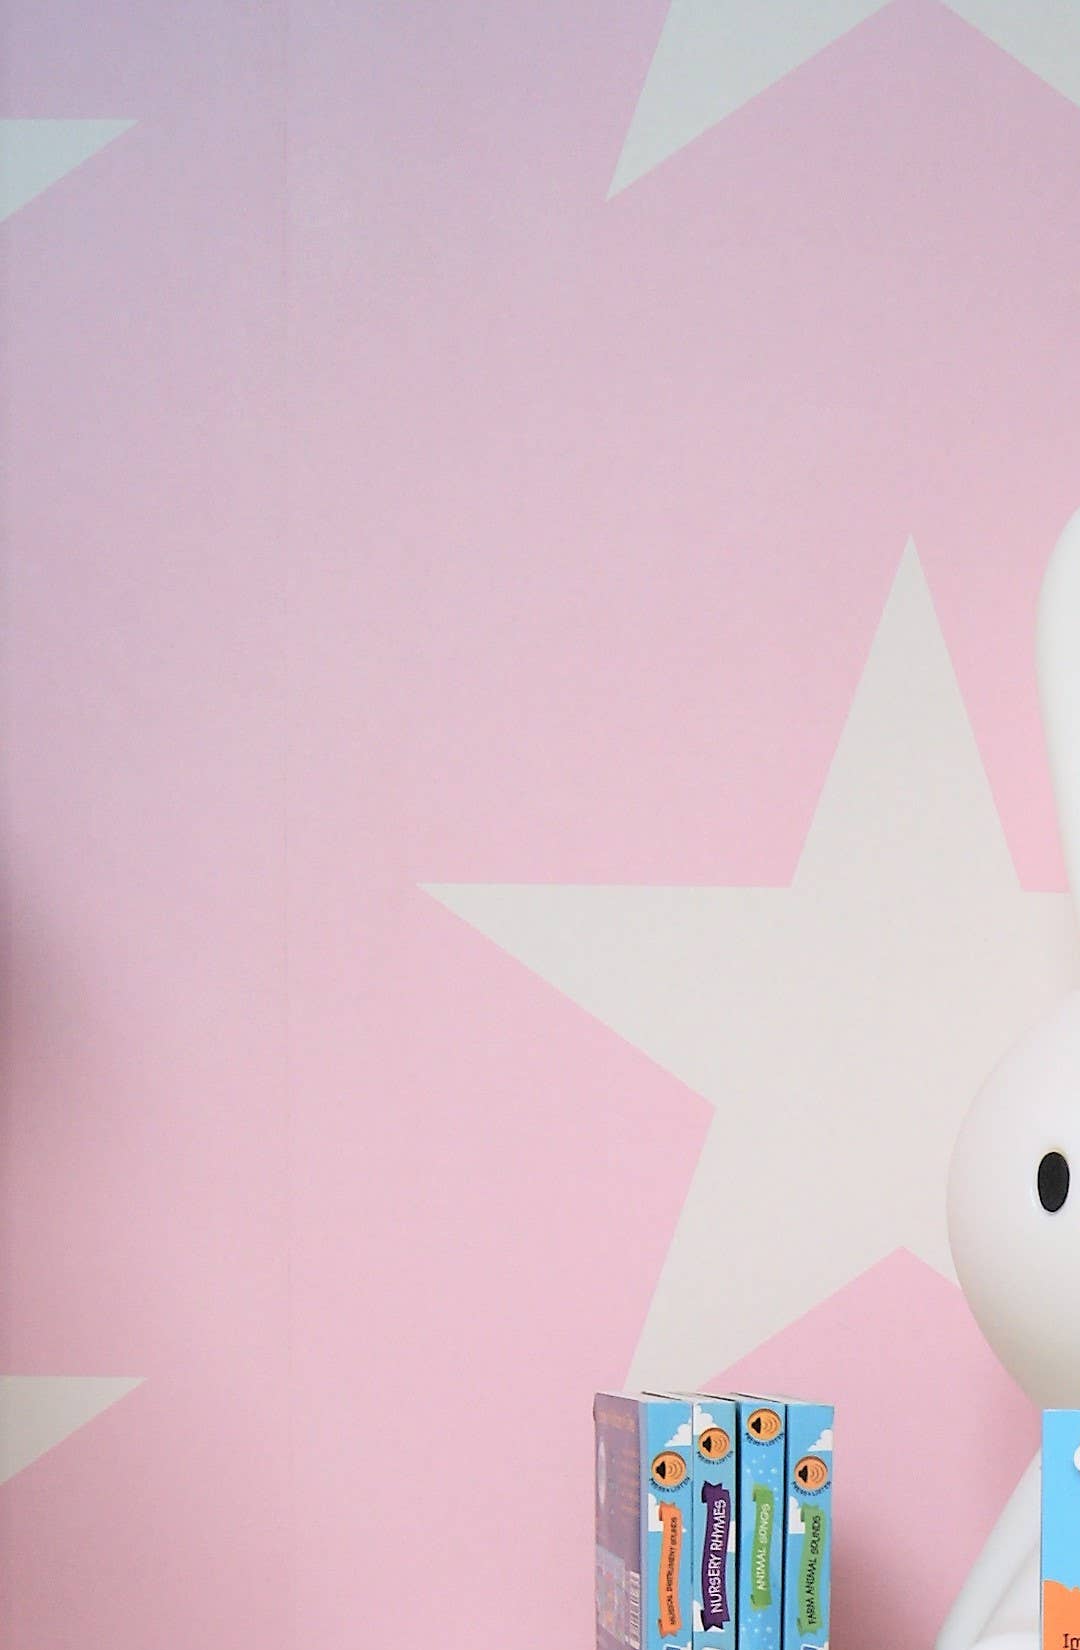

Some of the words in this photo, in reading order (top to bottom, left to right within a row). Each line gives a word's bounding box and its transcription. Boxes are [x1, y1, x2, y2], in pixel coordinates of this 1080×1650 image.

[710, 1499, 728, 1551] RHYMES
[759, 1503, 771, 1544] SONGS
[708, 1555, 723, 1614] NURSERY
[756, 1550, 768, 1591] ANIMAL
[805, 1558, 817, 1595] ANIMAL
